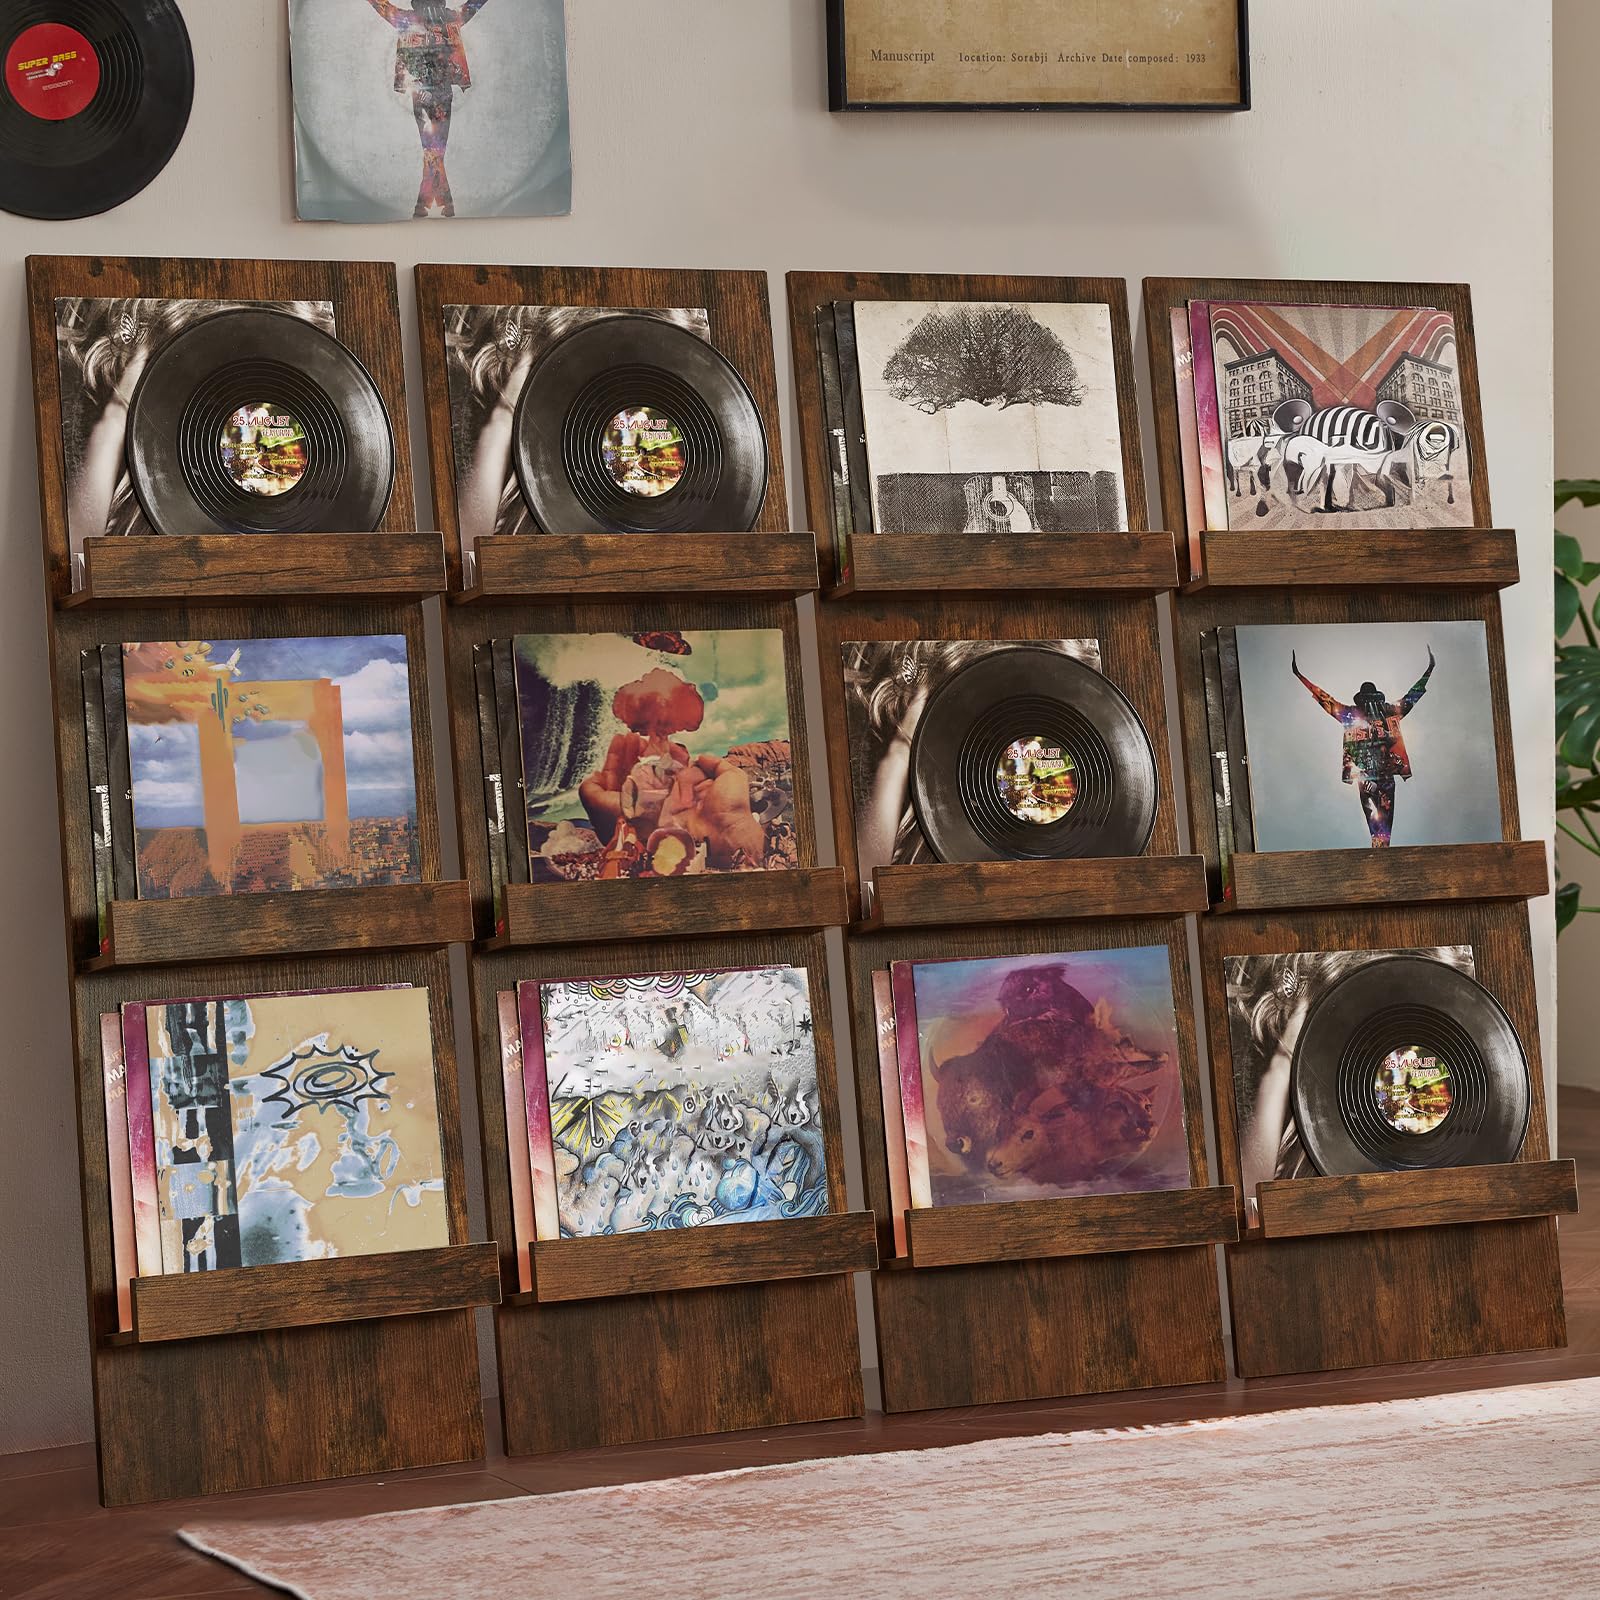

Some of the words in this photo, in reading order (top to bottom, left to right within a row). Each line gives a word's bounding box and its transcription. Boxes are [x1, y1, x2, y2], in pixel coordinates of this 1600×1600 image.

[18, 57, 48, 70] SUPER
[53, 51, 77, 62] BASS
[871, 49, 935, 64] Manuscript
[959, 53, 1006, 62] location:
[1011, 53, 1048, 64] Sorabji
[1058, 53, 1096, 63] Archive
[1102, 53, 1123, 63] Date
[1128, 53, 1179, 65] composed:
[1186, 53, 1206, 63] 1933
